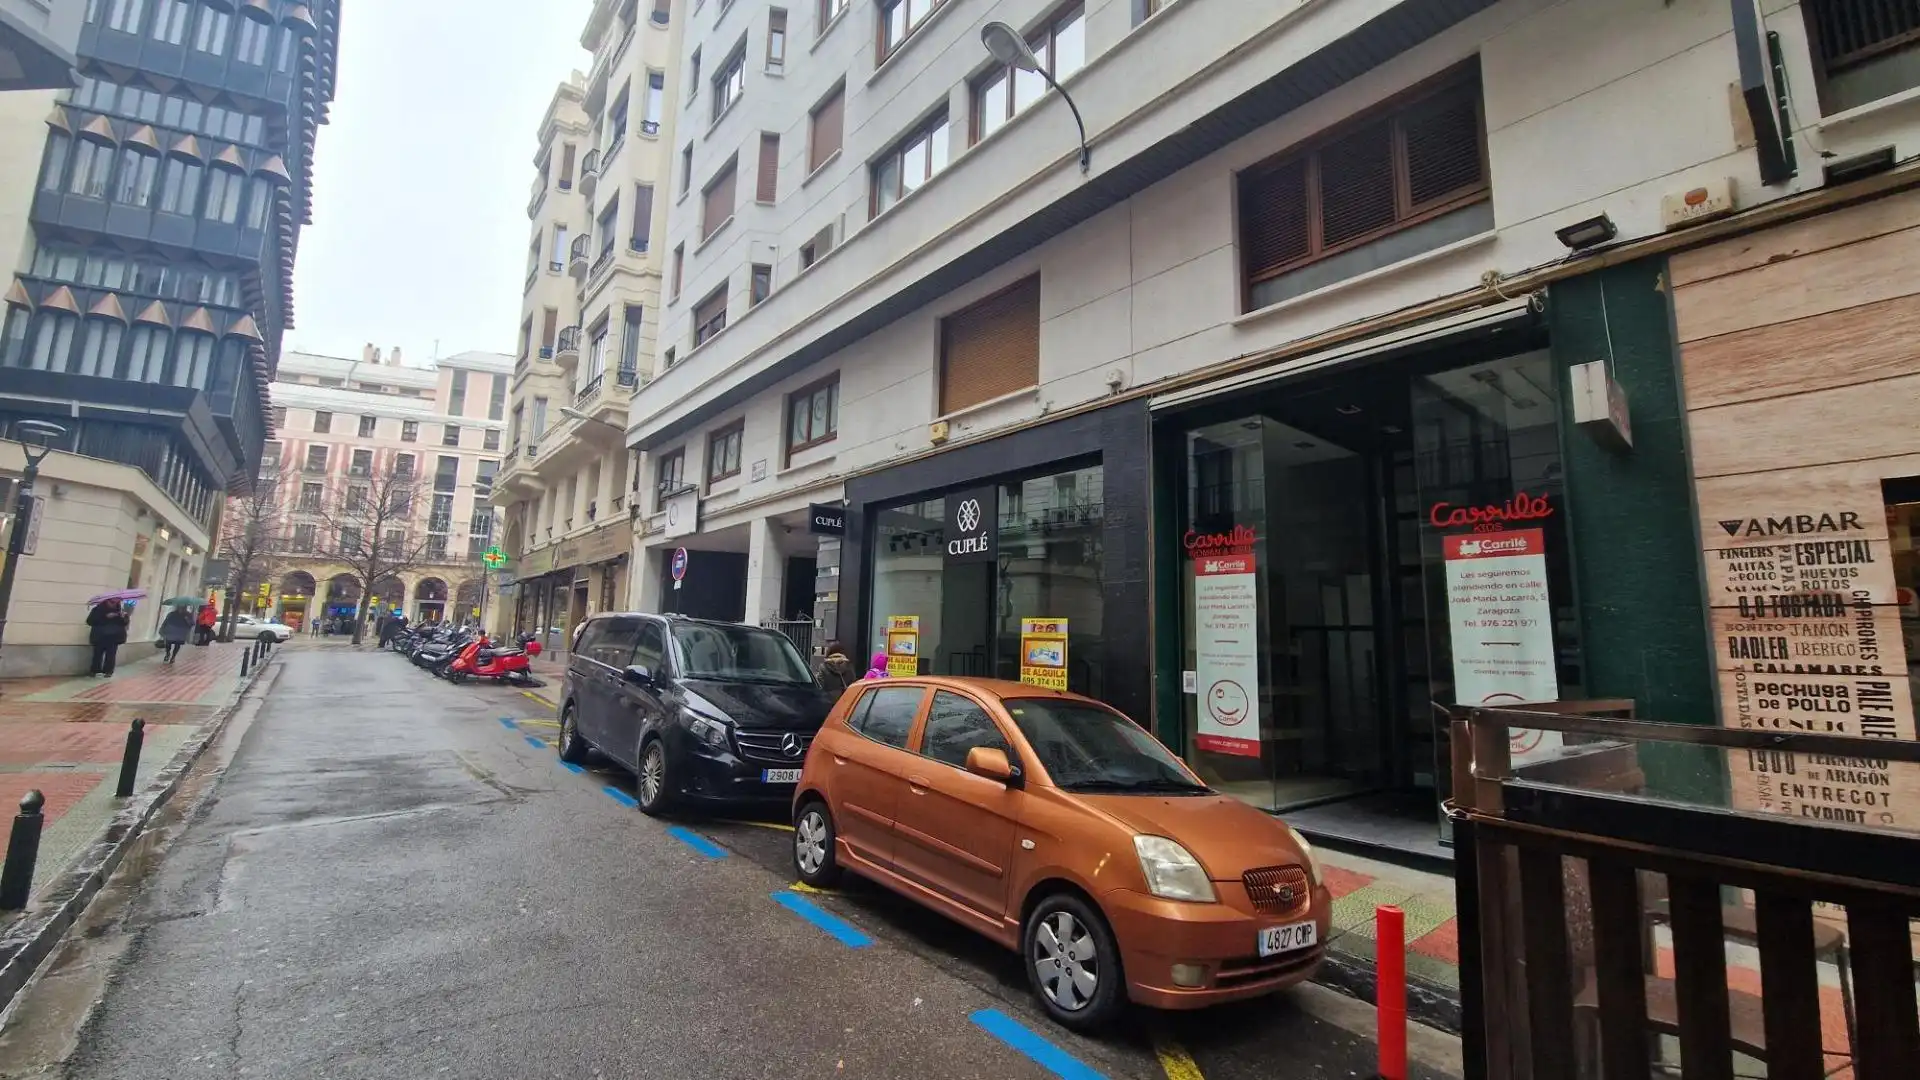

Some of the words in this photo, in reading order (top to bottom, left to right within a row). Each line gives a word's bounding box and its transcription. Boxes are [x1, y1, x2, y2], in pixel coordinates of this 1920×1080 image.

[815, 516, 843, 528] CUPLÉ
[1745, 511, 1864, 537] AMBAR
[948, 531, 988, 555] CUPLÉ
[1481, 537, 1527, 550] Carrilé
[1719, 547, 1775, 560] FINGERS
[1795, 540, 1875, 566] ESPECIAL
[1728, 561, 1775, 572] ALITAS
[1778, 544, 1796, 592] PAPAS
[1800, 567, 1859, 579] HUEVOS
[1460, 571, 1475, 579] Les
[1478, 569, 1531, 578] seguiremos
[1738, 571, 1777, 581] POLLO
[1519, 580, 1542, 588] calle
[1801, 580, 1850, 591] ROTOS
[1738, 595, 1766, 620] 0,0
[1769, 594, 1846, 618] TOSTADA
[1502, 619, 1518, 627] 221
[1520, 619, 1537, 627] 971
[1725, 623, 1786, 632] BONITO
[1728, 636, 1789, 660] RADLER
[1023, 667, 1031, 675] SE
[1033, 668, 1066, 678] ALQUILA
[1753, 662, 1883, 676] CALAMARES
[1037, 677, 1050, 685] 374
[1052, 679, 1065, 687] 135
[1855, 681, 1894, 712] PALE
[1787, 698, 1851, 713] POLLO
[1859, 714, 1897, 739] ALE
[1746, 749, 1797, 775] 1900
[769, 770, 794, 781] 2908
[1825, 768, 1890, 787] ARAGÓN
[1780, 782, 1891, 807] ENTRECOT
[1267, 927, 1292, 950] 4827
